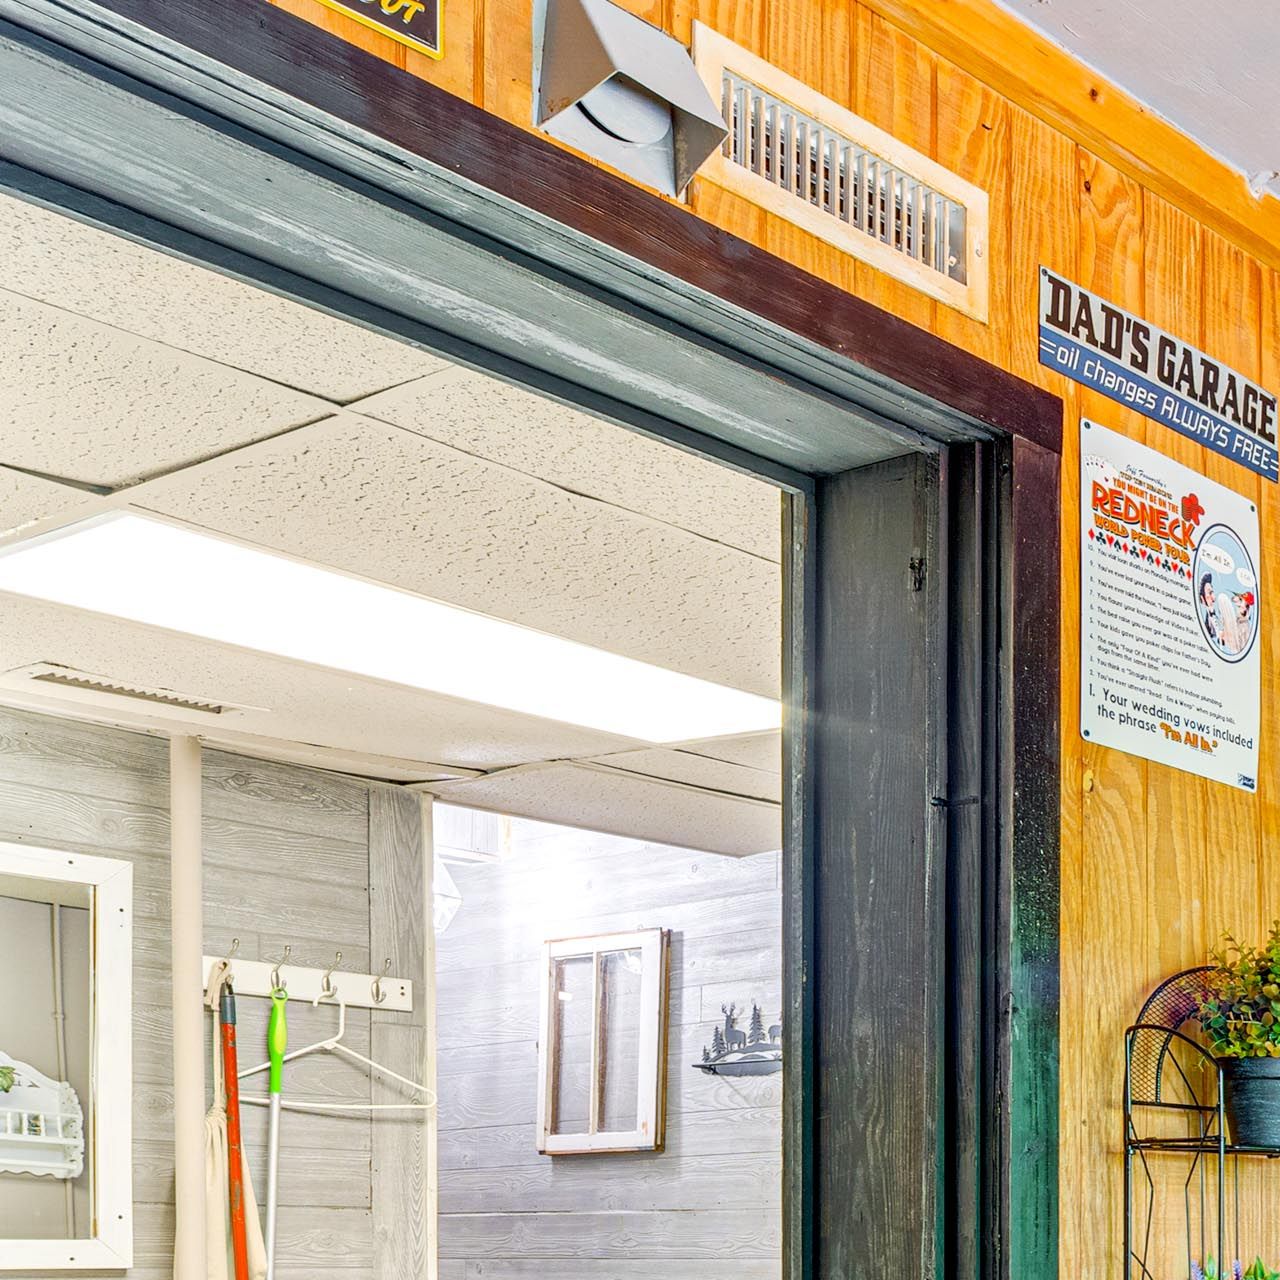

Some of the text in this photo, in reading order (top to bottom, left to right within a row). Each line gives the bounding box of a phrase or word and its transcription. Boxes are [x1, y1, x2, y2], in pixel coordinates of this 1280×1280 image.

[1046, 274, 1276, 445] DAD'S GARAGE
[1057, 345, 1272, 471] oil changes ALWAYS FREE
[1091, 480, 1199, 551] REDNECK
[1094, 513, 1129, 539] WORLD
[1164, 543, 1191, 566] TOUR
[1098, 704, 1198, 748] the phrase All
[1102, 687, 1127, 706] Your
[1132, 699, 1181, 727] wedding
[1184, 717, 1210, 735] vows
[1212, 725, 1253, 750] included
